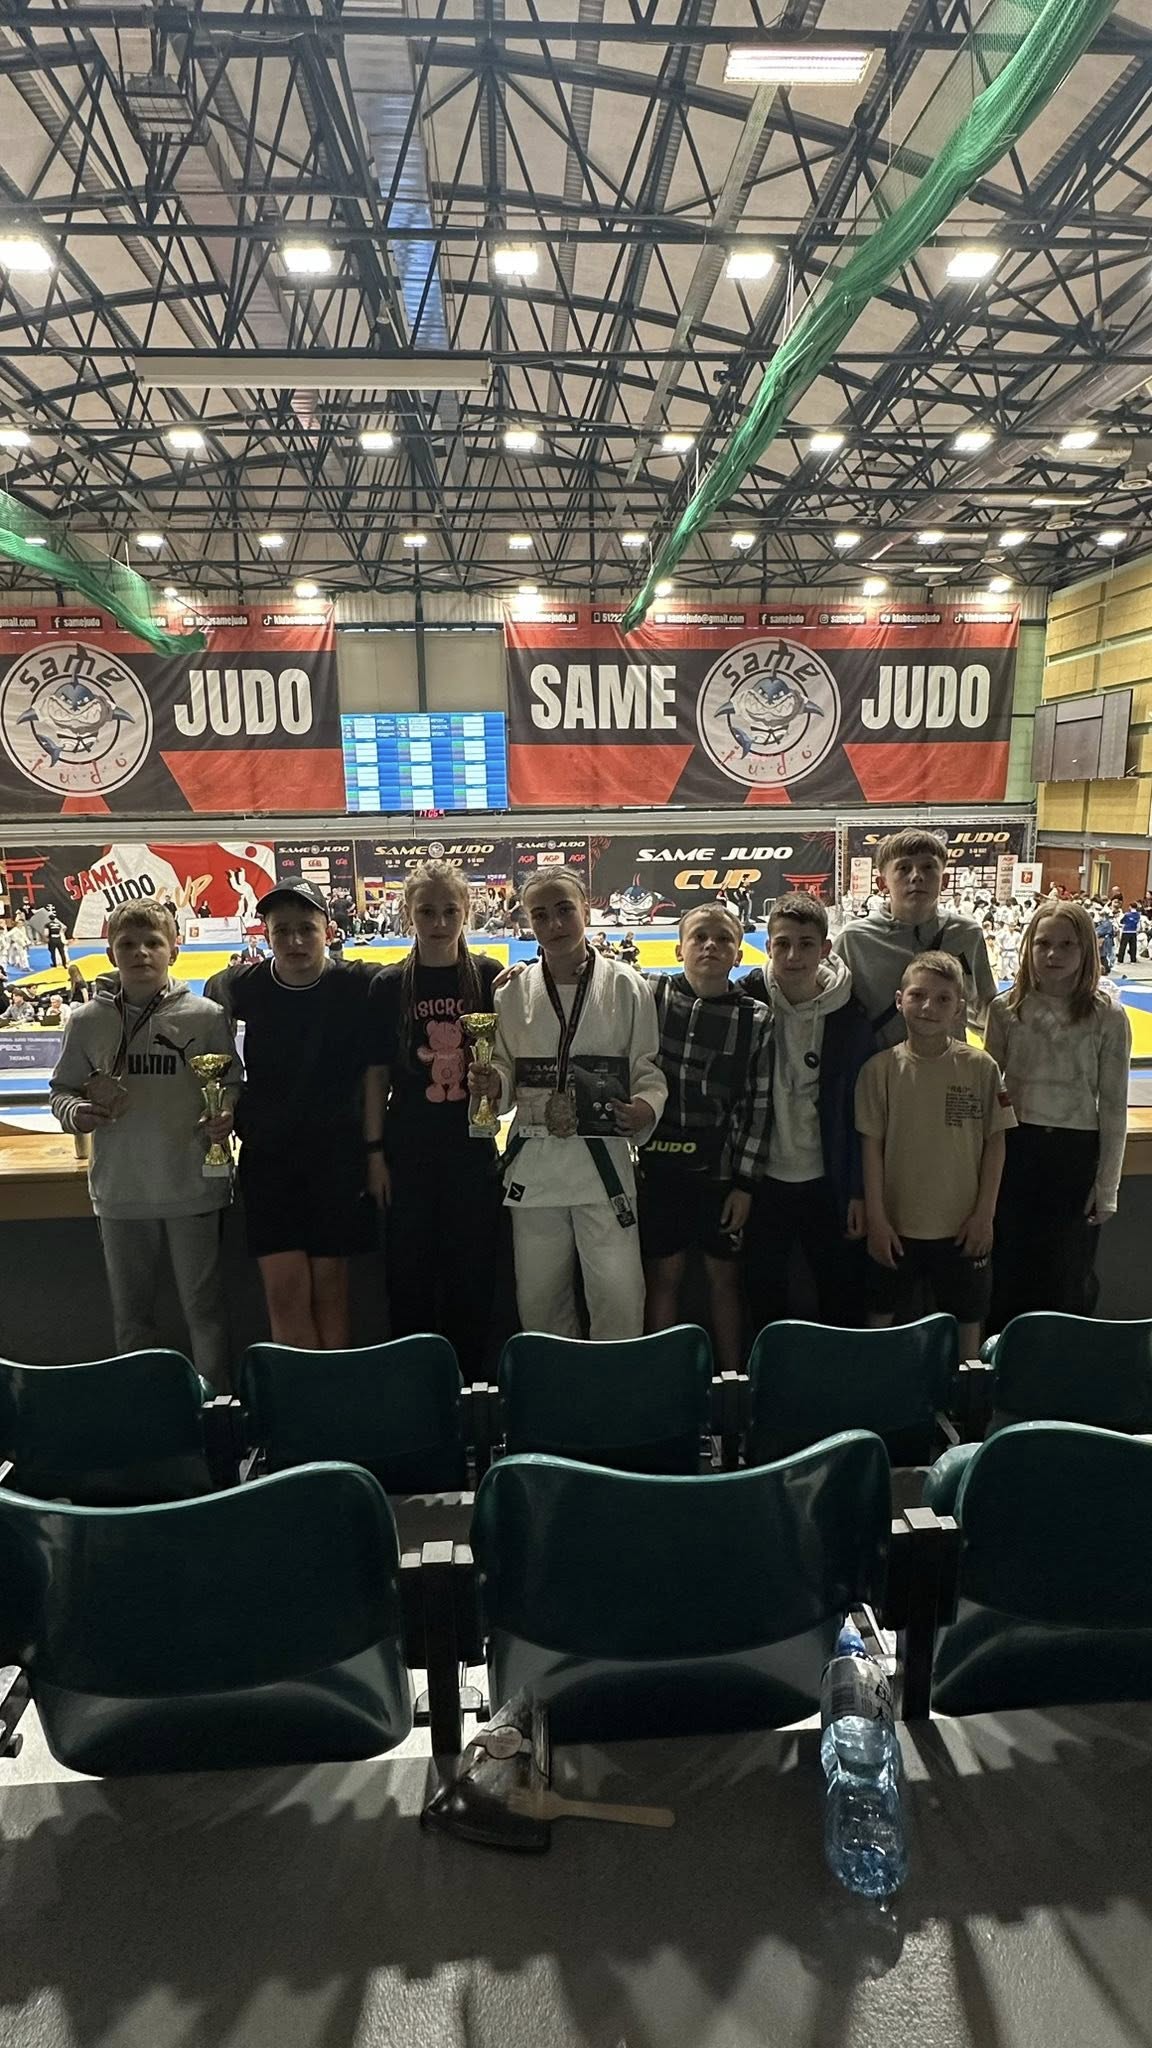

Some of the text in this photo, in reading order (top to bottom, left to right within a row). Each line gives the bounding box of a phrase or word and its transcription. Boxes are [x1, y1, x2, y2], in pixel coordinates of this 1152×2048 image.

[64, 617, 100, 627] samejudo
[770, 614, 804, 625] samejudo
[174, 668, 313, 737] JUDO
[529, 664, 677, 731] SAME
[861, 664, 990, 731] JUDO
[948, 832, 1011, 844] JUDO
[374, 844, 495, 856] SAME JUDO
[636, 846, 794, 862] SAME JUDO
[518, 855, 535, 863] AGP
[569, 854, 586, 862] AGP
[64, 861, 123, 900] SAME
[674, 868, 762, 890] CUP
[103, 874, 156, 912] JUDO
[645, 1140, 697, 1153] JUDO
